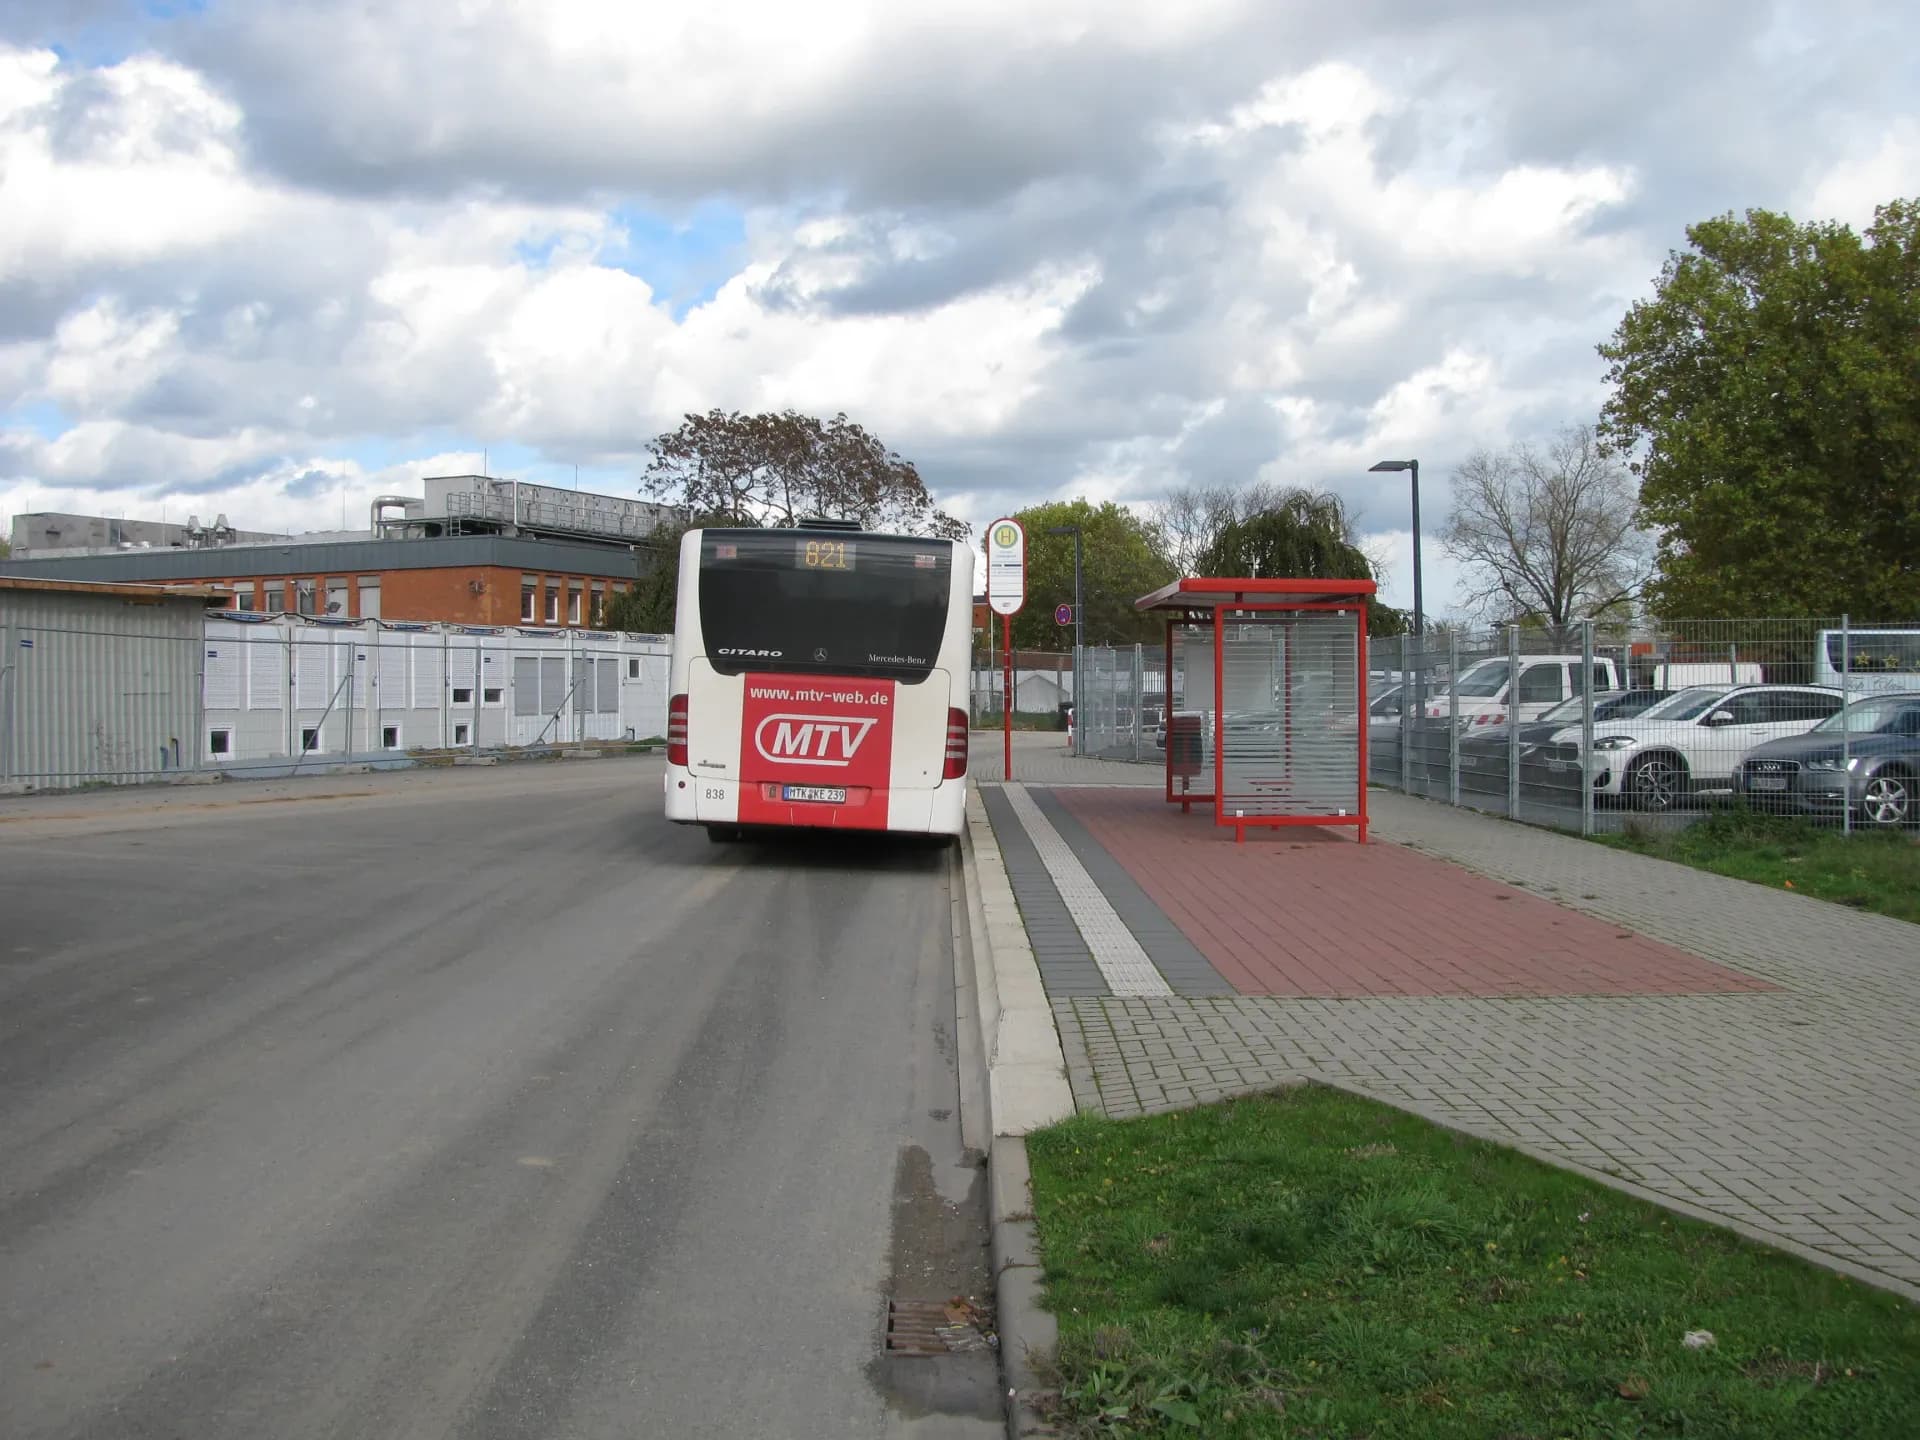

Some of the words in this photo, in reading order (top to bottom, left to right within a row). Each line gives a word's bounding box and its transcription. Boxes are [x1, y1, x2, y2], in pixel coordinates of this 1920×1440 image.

[1001, 529, 1011, 543] H
[805, 541, 846, 569] 821
[718, 648, 783, 658] CITARO
[868, 653, 927, 665] Mercedes-Benz
[750, 687, 889, 705] www.mtv-web.de
[772, 718, 879, 758] MTV
[705, 788, 725, 801] 838
[789, 787, 807, 799] MTK
[813, 789, 825, 800] KE
[827, 790, 845, 801] 239
